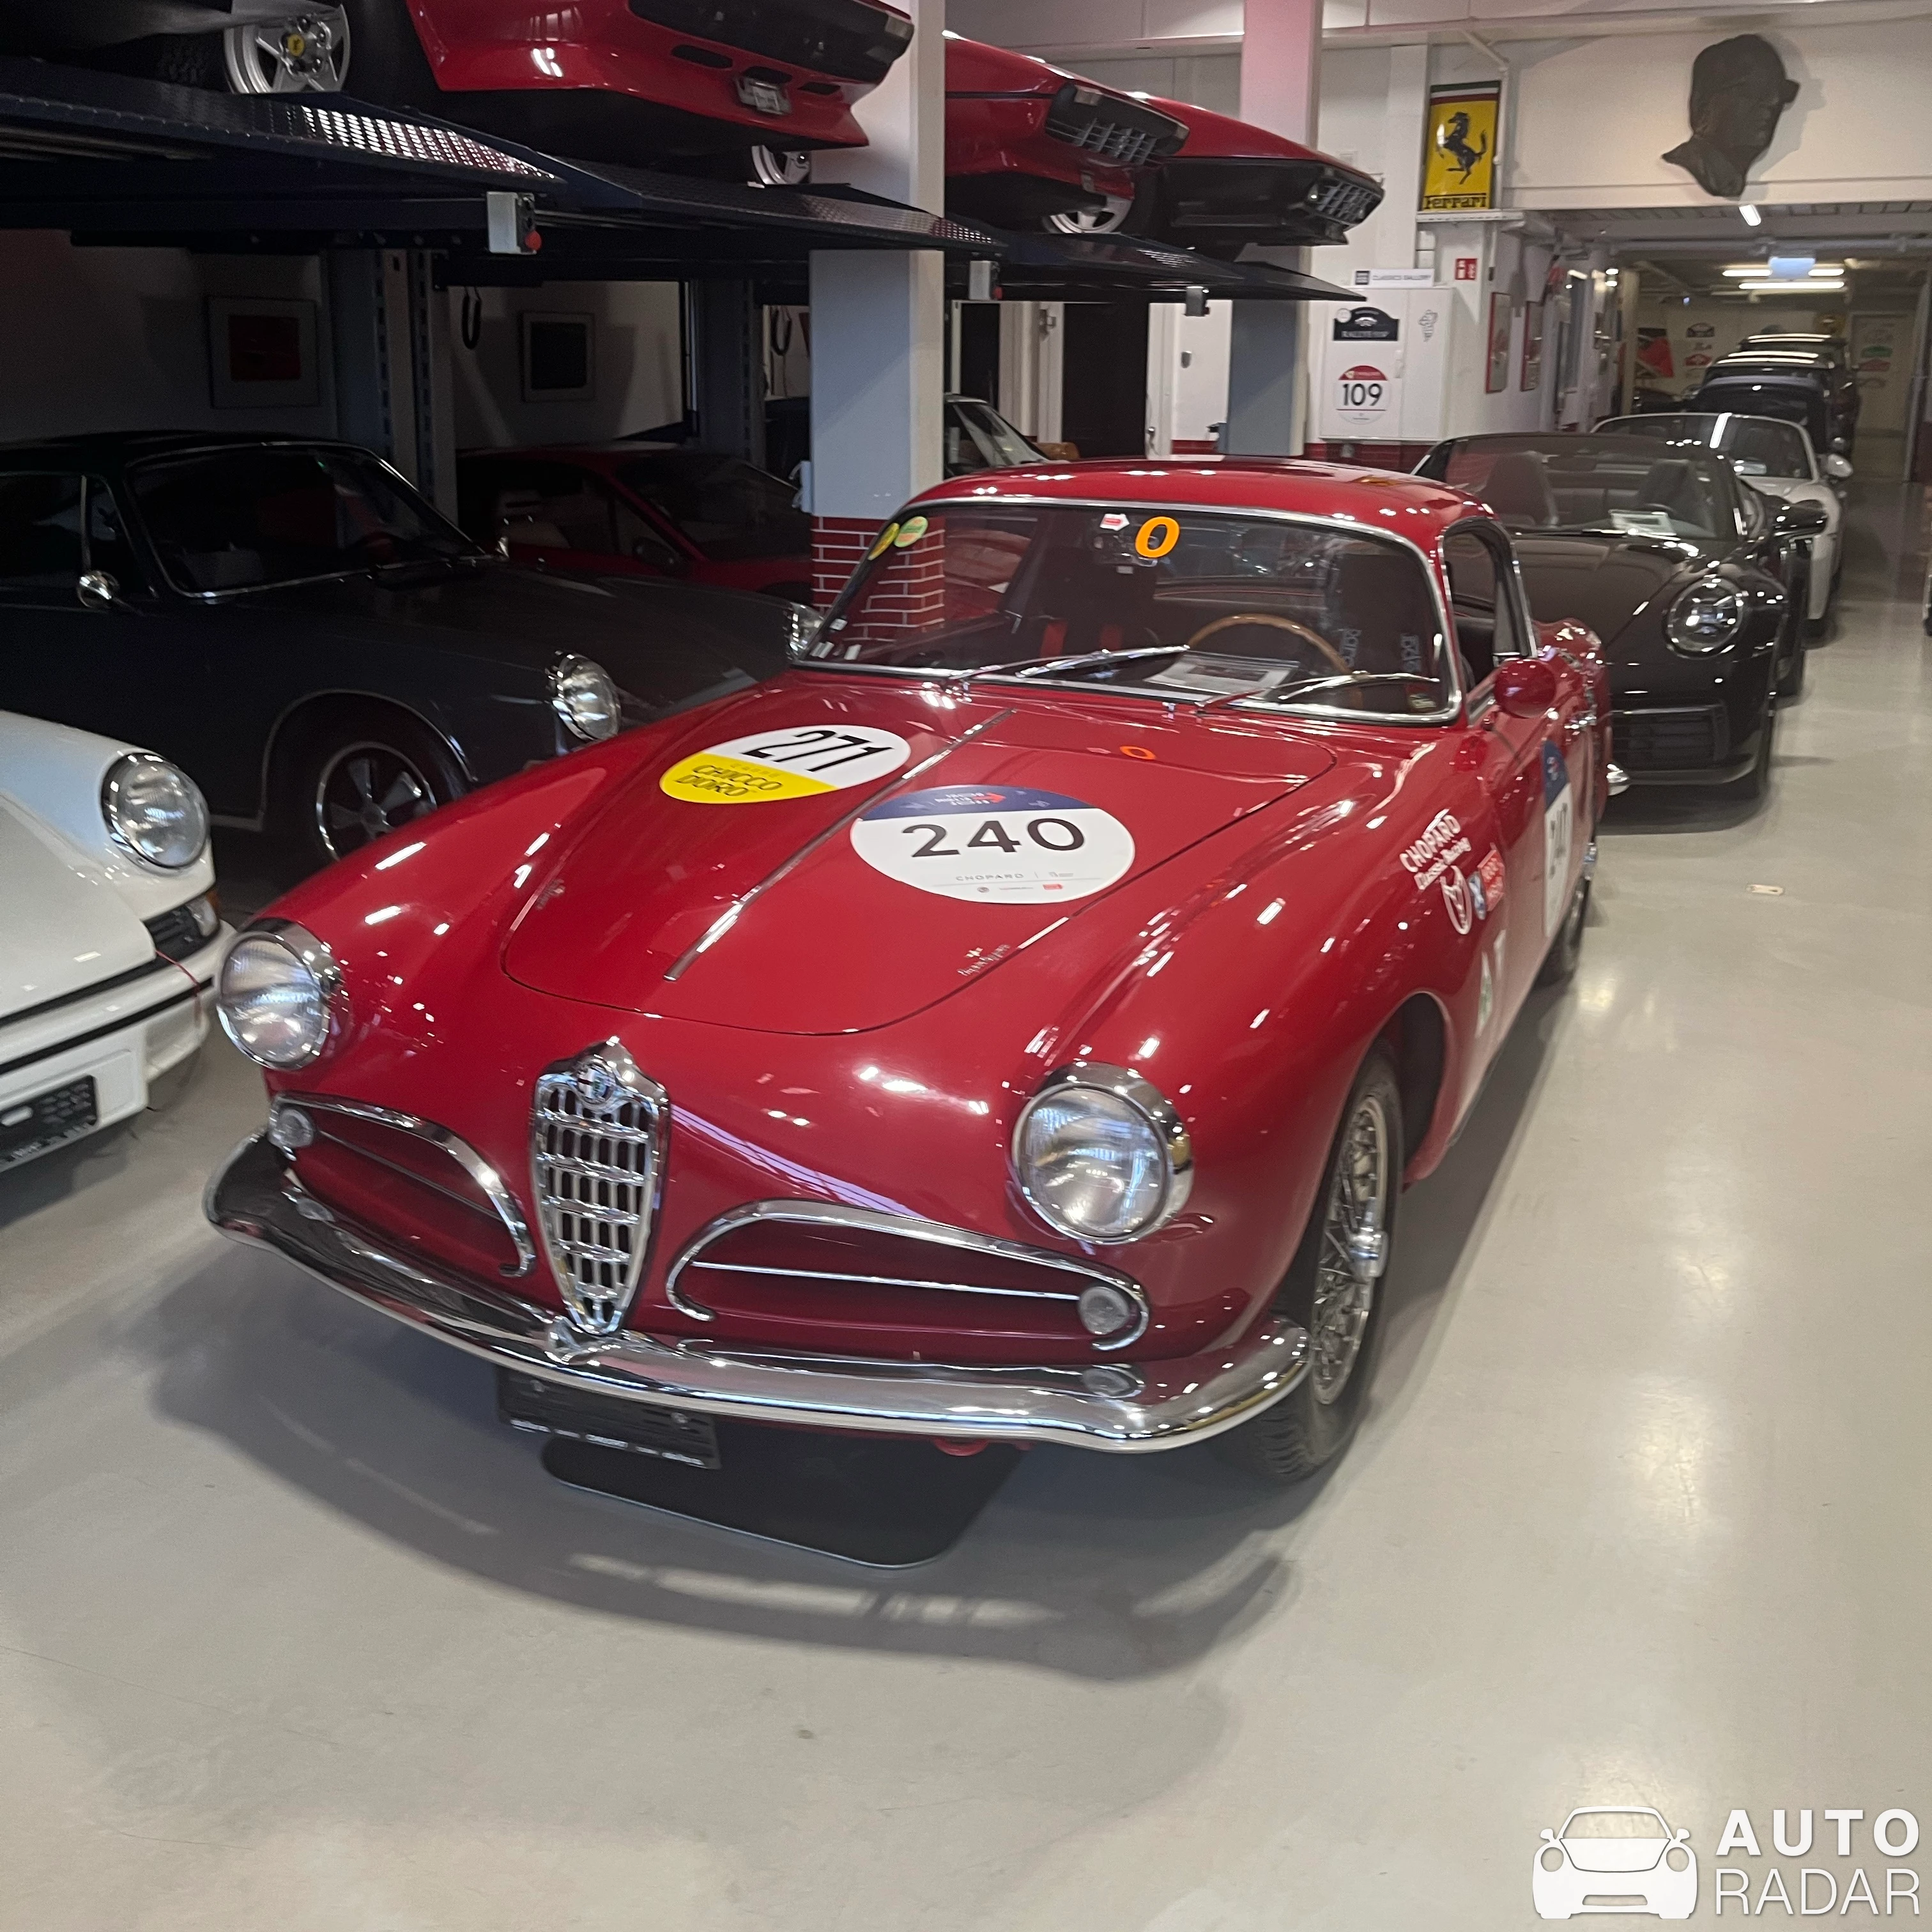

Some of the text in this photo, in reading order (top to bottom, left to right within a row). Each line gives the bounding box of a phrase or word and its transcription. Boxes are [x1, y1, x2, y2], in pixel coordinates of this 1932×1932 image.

[1342, 383, 1383, 406] 109
[741, 730, 894, 772] 271
[691, 765, 783, 790] CHICCO
[901, 818, 1085, 857] 240
[1399, 815, 1462, 873] CHOPARD
[956, 873, 1023, 882] CHOPARD
